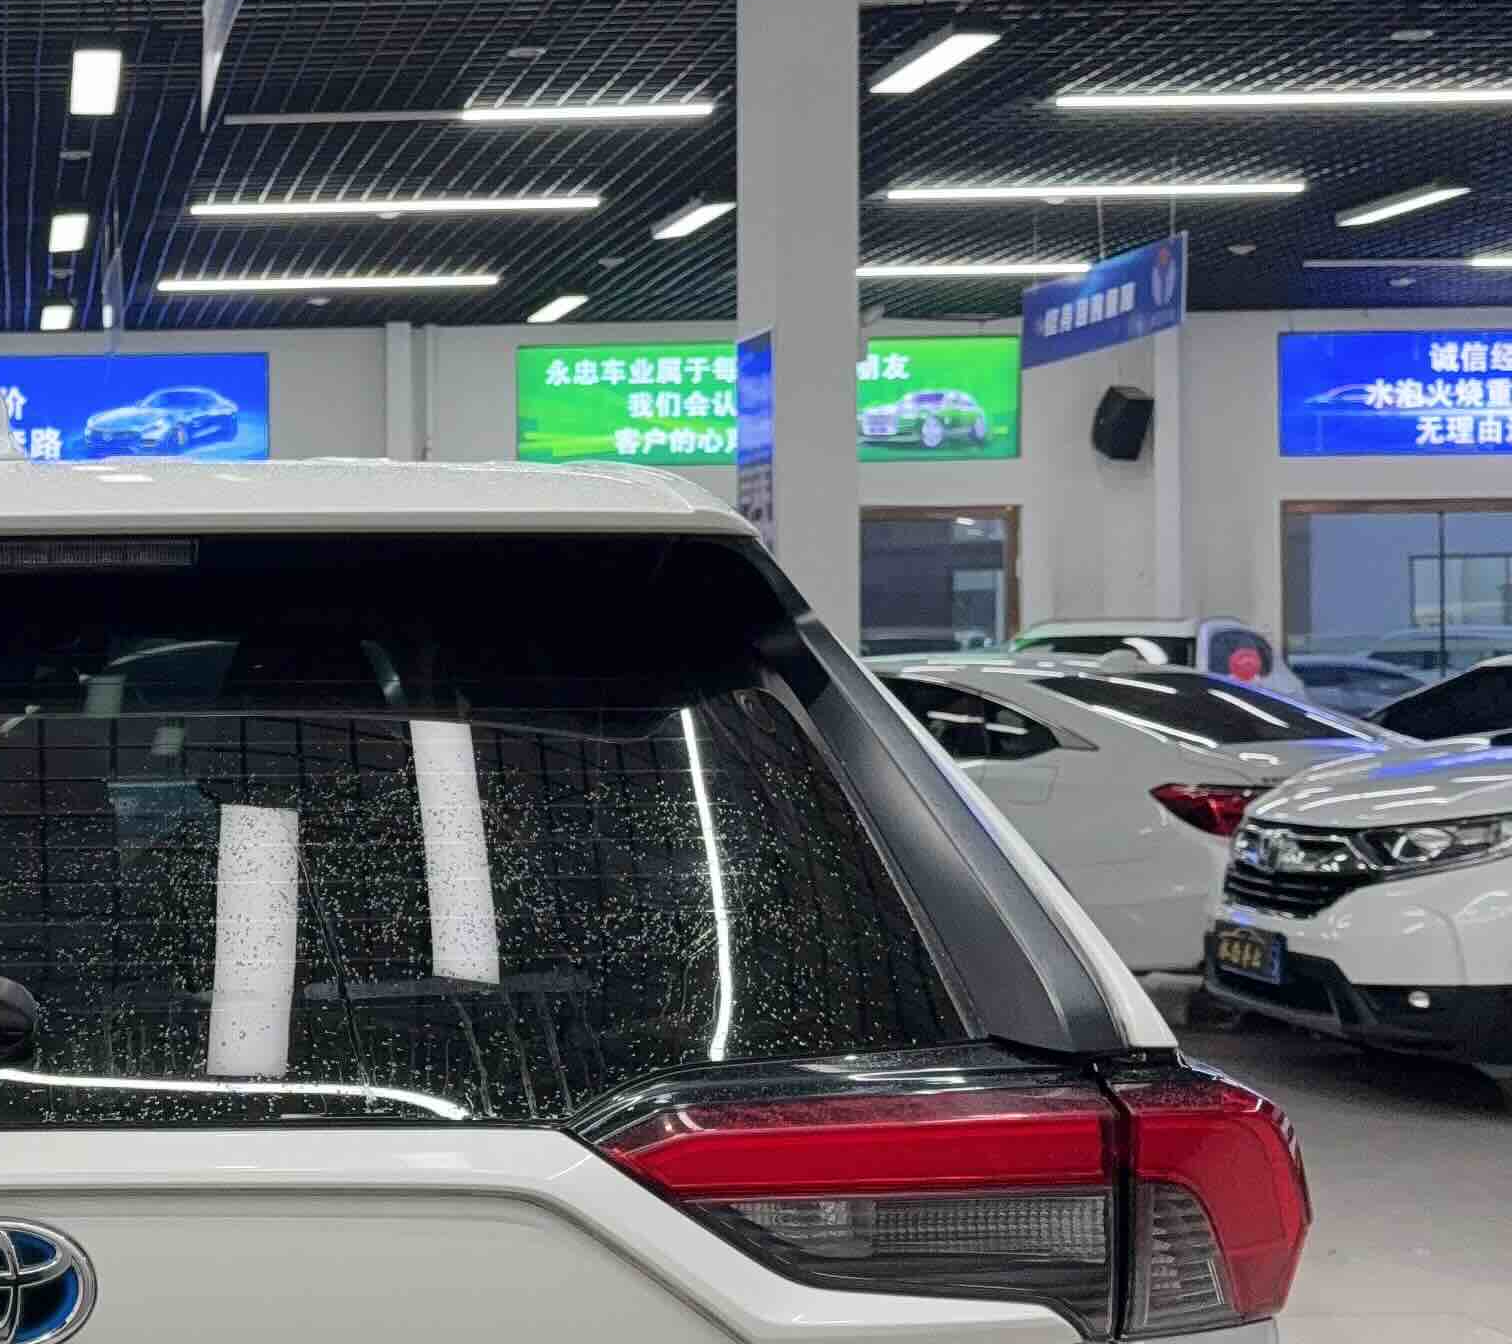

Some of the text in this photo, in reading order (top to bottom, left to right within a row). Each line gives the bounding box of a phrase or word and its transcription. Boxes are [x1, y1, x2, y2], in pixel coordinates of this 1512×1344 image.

[613, 426, 737, 456] 客户的心
[1415, 415, 1512, 446] 无理由
